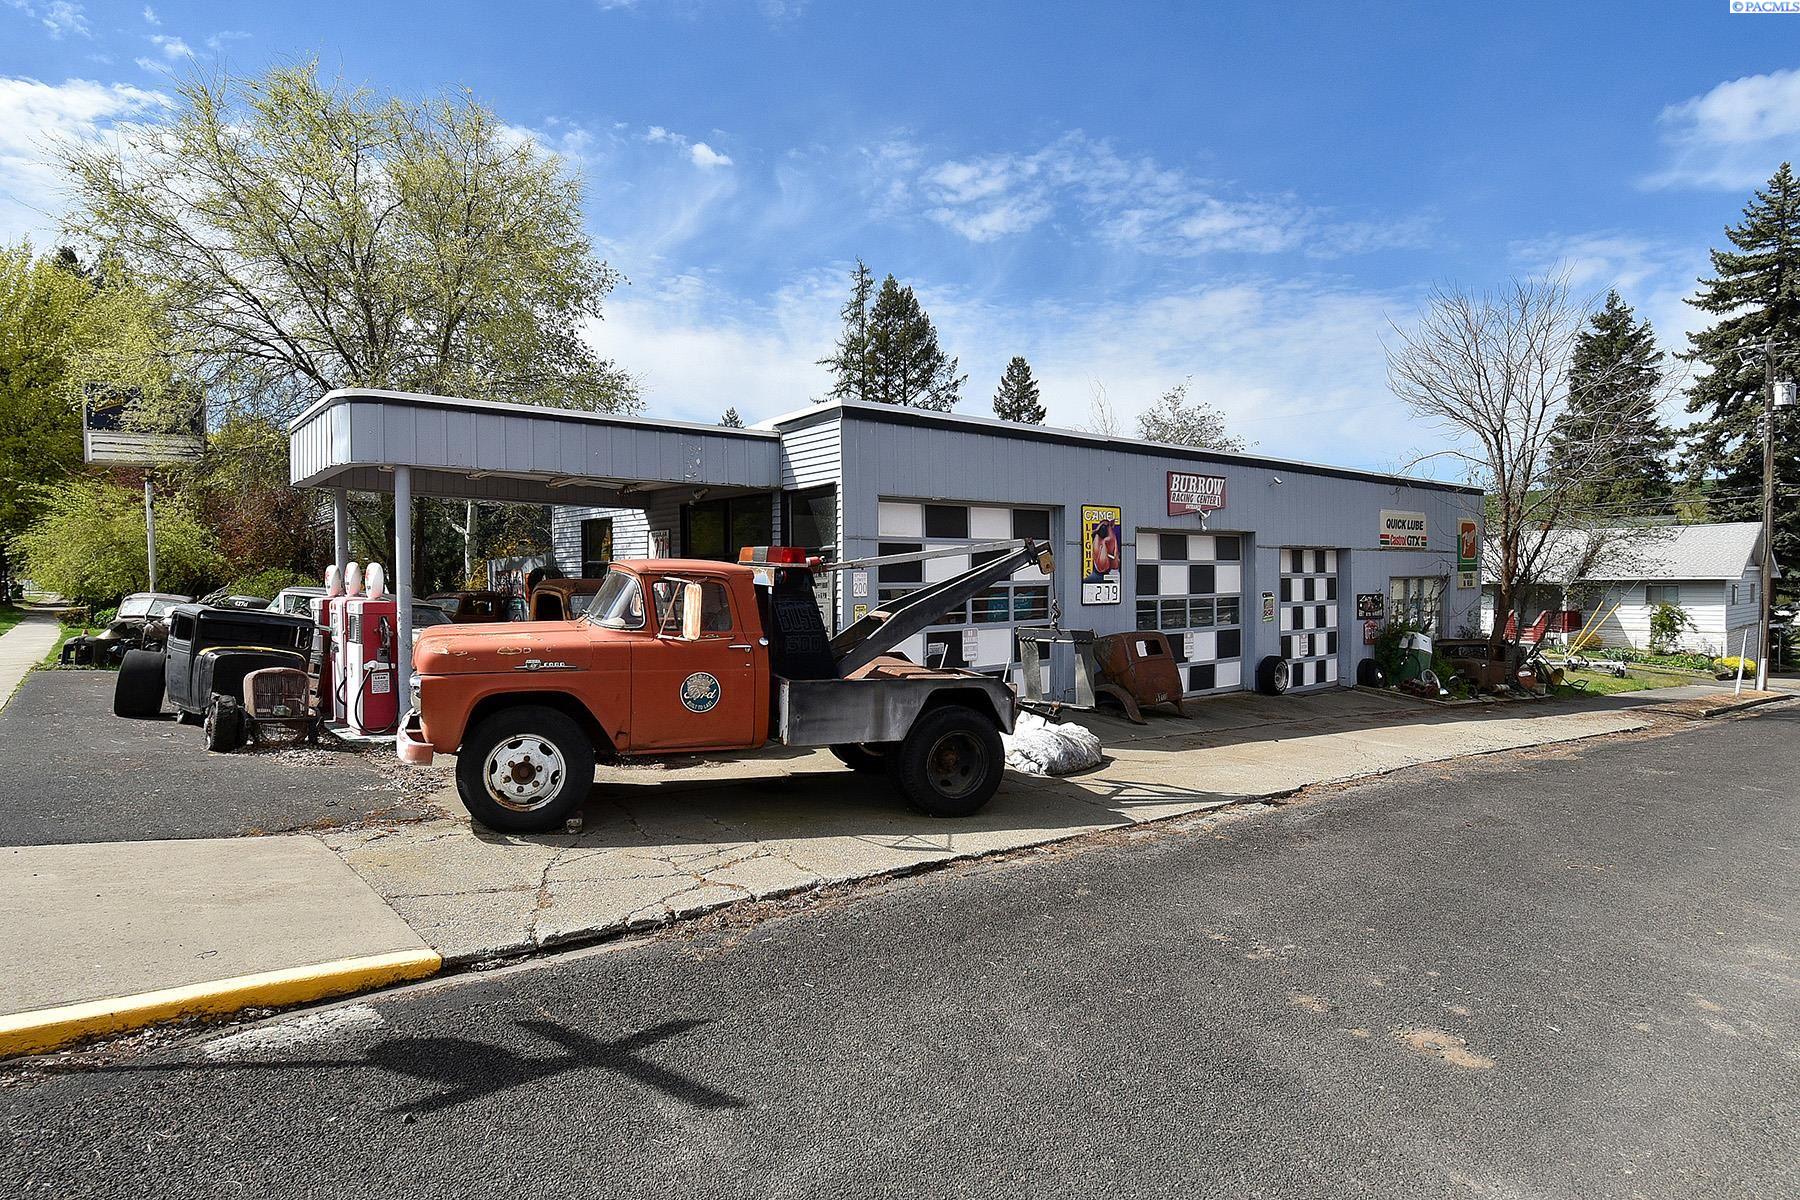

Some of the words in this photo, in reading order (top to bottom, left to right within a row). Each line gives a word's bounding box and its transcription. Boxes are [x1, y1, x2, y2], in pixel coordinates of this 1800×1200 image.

[1170, 474, 1225, 495] BURROW
[1172, 492, 1195, 503] RACING
[1196, 494, 1217, 505] CENTER
[1084, 510, 1119, 522] CAMEL
[1386, 518, 1407, 530] QUICK
[1407, 519, 1425, 531] LUBE
[1391, 534, 1407, 546] Castrol
[1407, 535, 1421, 547] GTX
[854, 583, 867, 594] 200
